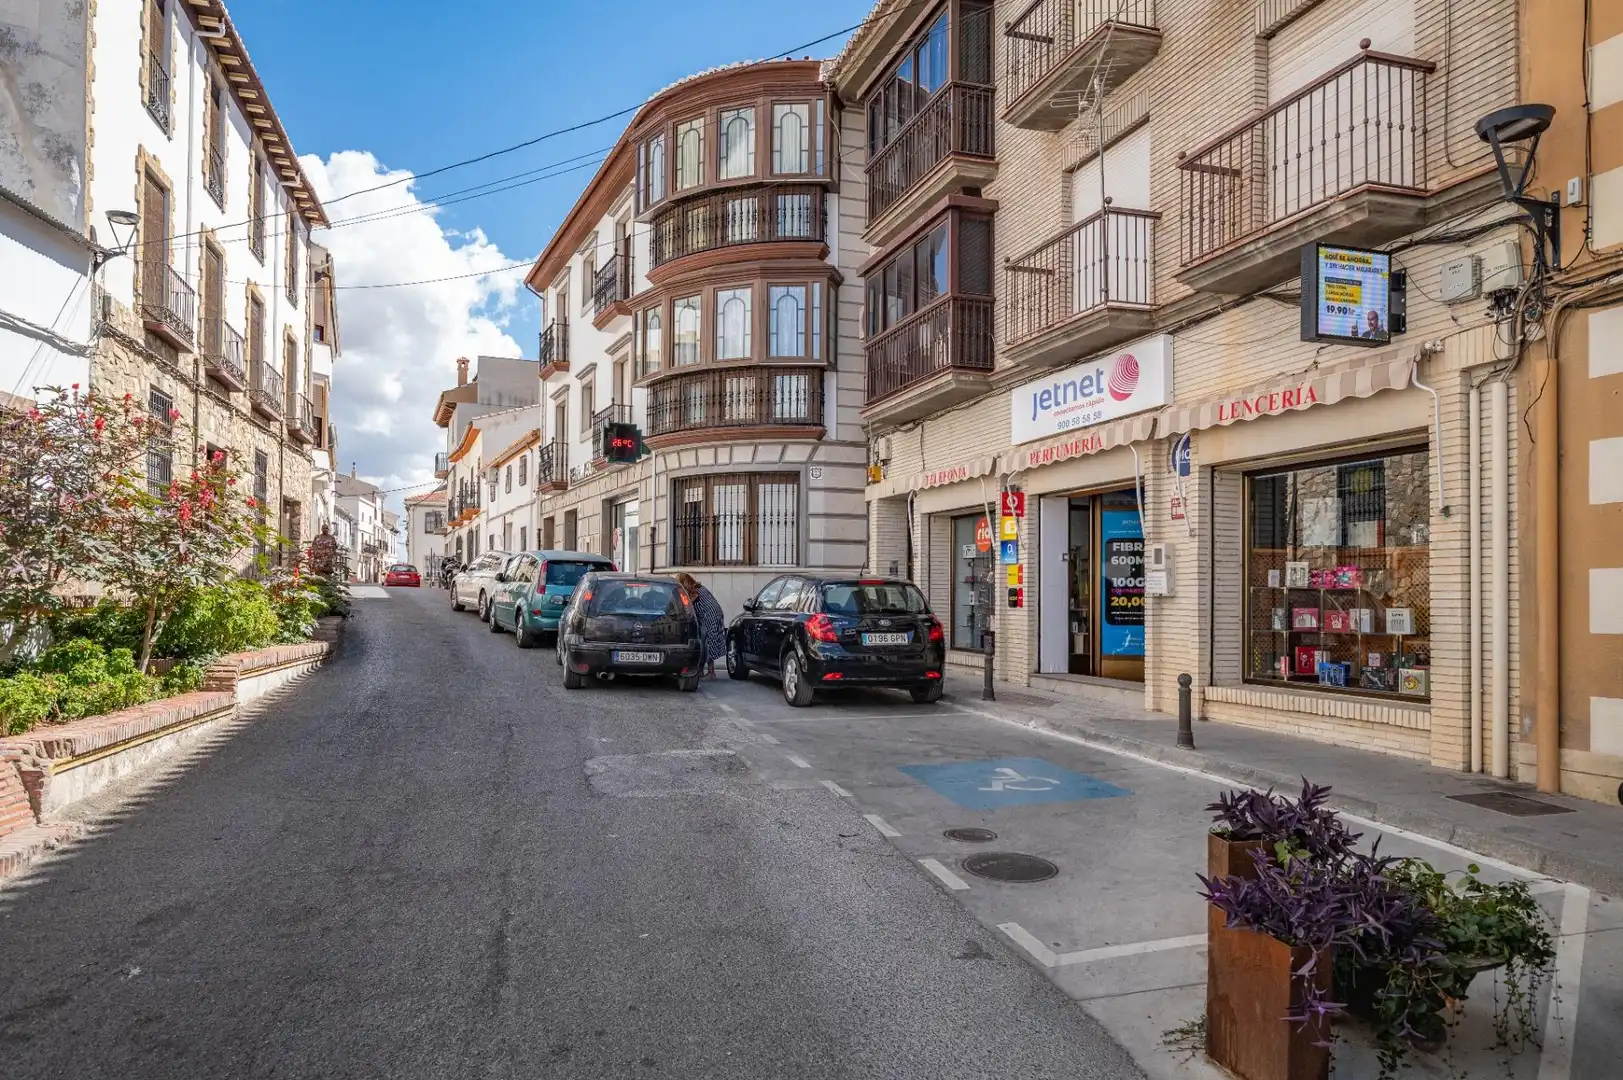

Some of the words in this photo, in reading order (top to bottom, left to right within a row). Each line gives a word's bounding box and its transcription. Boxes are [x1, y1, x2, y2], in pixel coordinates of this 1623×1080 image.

[1032, 368, 1104, 421] jetnet
[1219, 381, 1317, 422] LENCERÍA
[1057, 420, 1070, 430] 900
[1071, 416, 1081, 426] 58
[1082, 413, 1091, 424] 58
[1093, 411, 1102, 421] 58
[1030, 431, 1103, 465] PERFUMERÍA
[1112, 542, 1145, 552] FIBR
[620, 652, 640, 661] 6035
